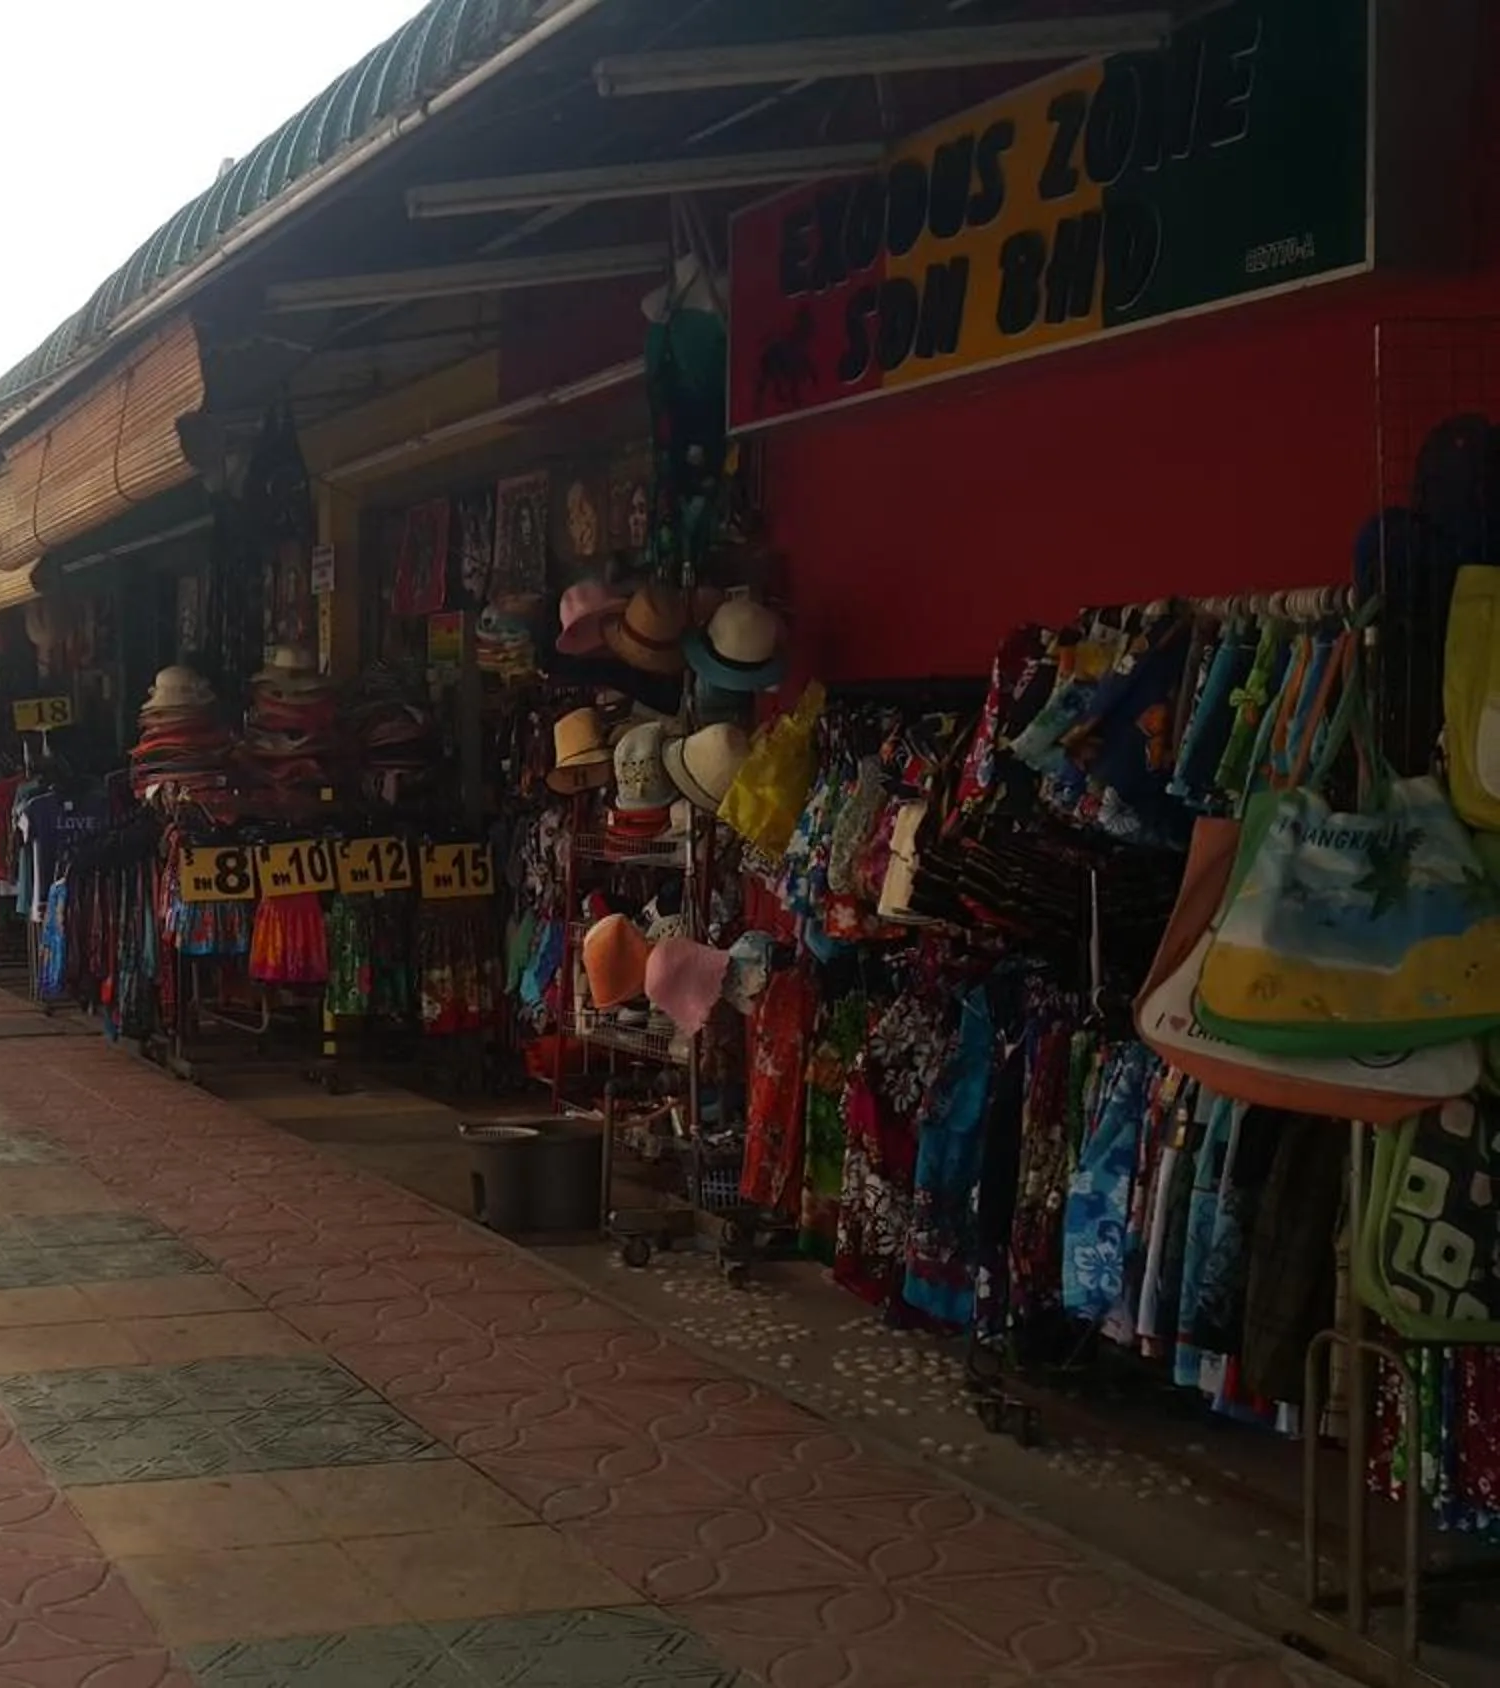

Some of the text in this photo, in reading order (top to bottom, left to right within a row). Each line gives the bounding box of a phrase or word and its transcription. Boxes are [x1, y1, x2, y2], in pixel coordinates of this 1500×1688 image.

[779, 14, 1263, 298] EXODUS ZONE
[839, 202, 1161, 384] SDN BHD
[215, 851, 250, 894] 8
[289, 845, 327, 884] 10
[367, 842, 407, 882] 12
[452, 850, 489, 887] 15
